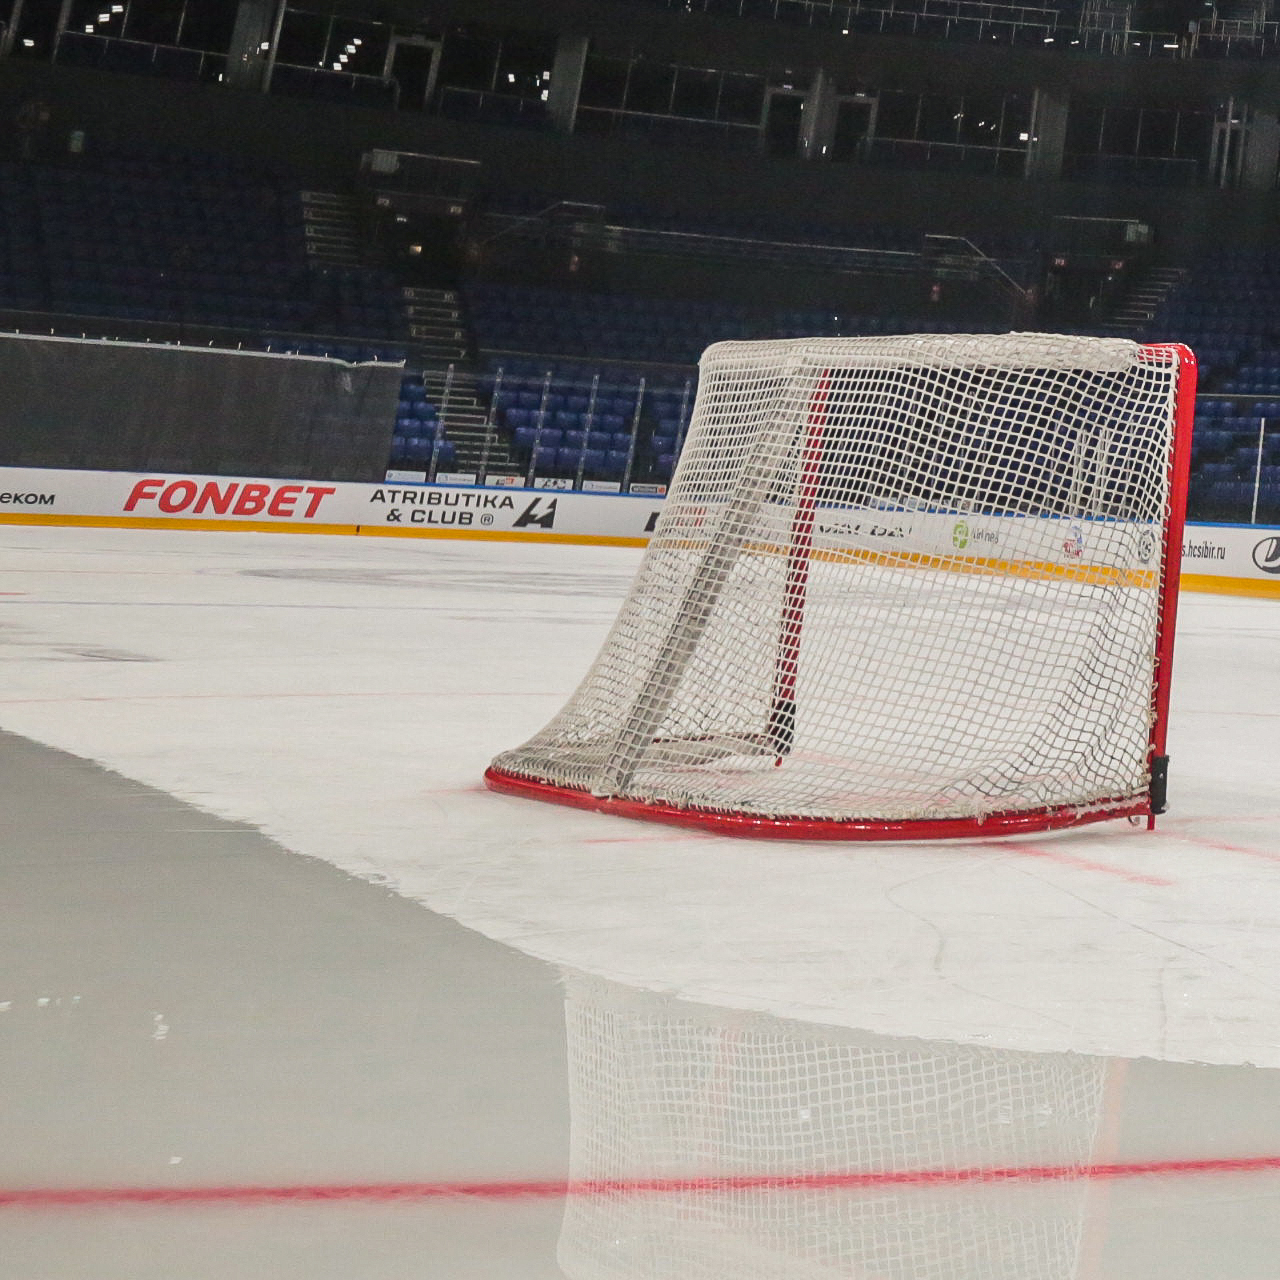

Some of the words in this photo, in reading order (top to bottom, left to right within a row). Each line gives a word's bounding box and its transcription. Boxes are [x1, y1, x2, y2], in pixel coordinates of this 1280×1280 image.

[123, 478, 337, 519] FONBET
[369, 489, 515, 510] ATRIBUTIKA
[386, 508, 403, 523] &
[410, 509, 474, 526] CLUB
